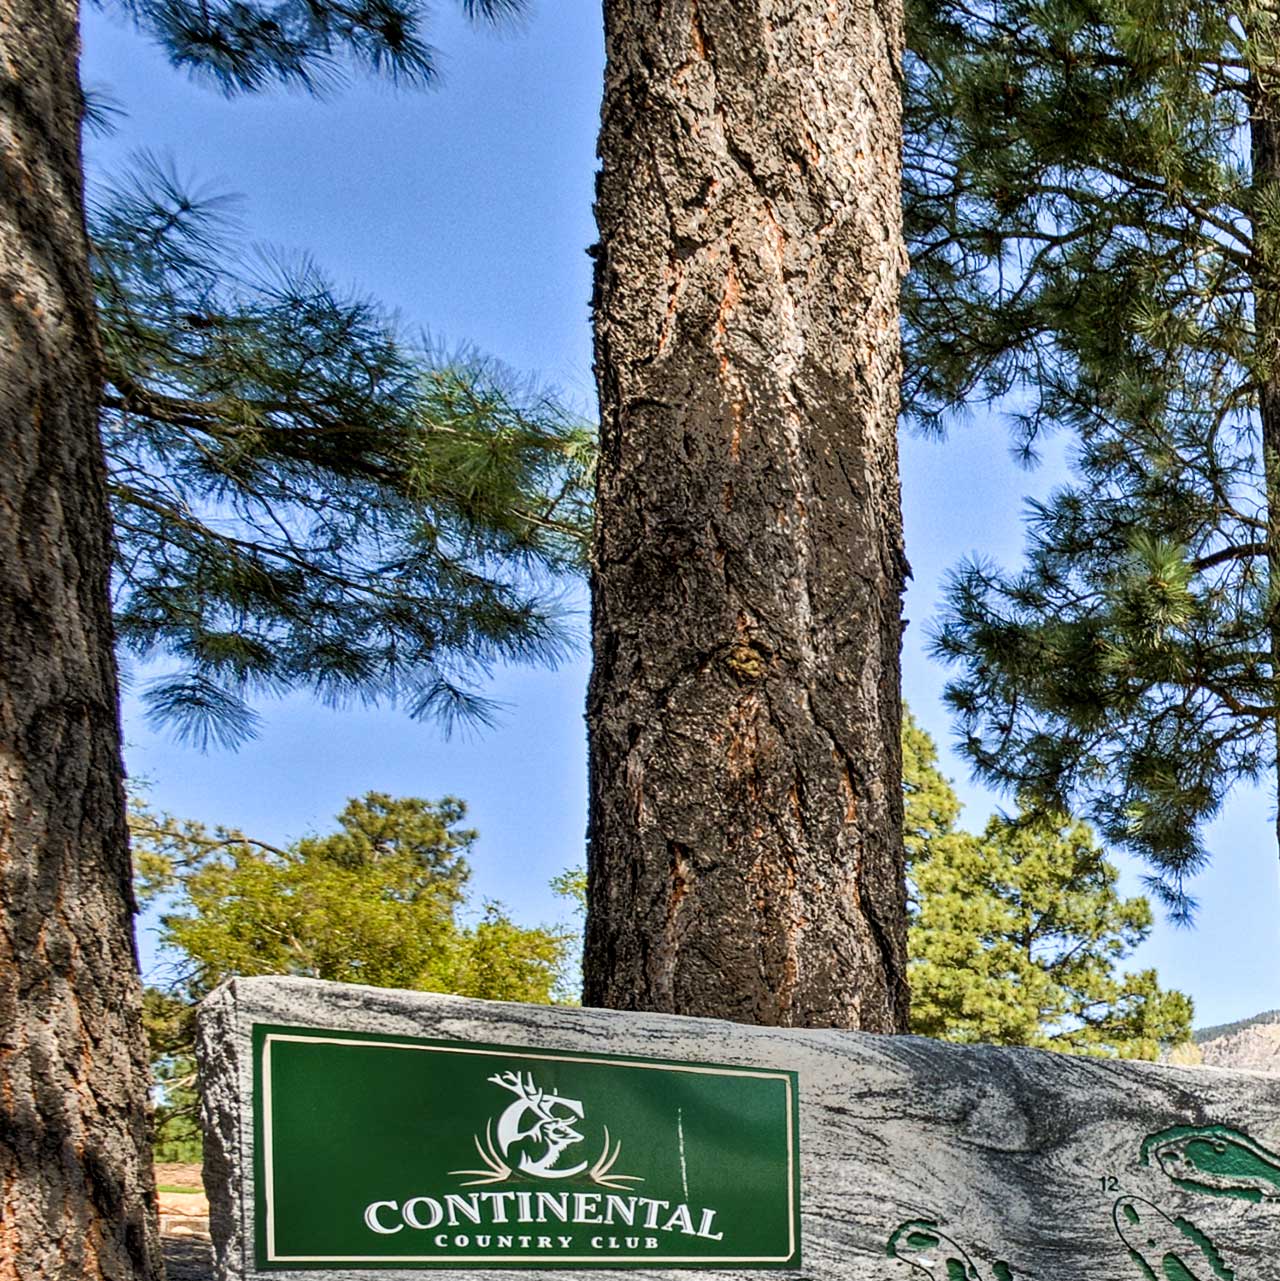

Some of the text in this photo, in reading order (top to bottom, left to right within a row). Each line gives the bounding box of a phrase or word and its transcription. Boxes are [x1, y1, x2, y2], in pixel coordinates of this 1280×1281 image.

[1100, 1176, 1119, 1192] 12
[364, 1191, 724, 1240] CONTINENTAL
[435, 1235, 659, 1249] COUNTRY CLUB
